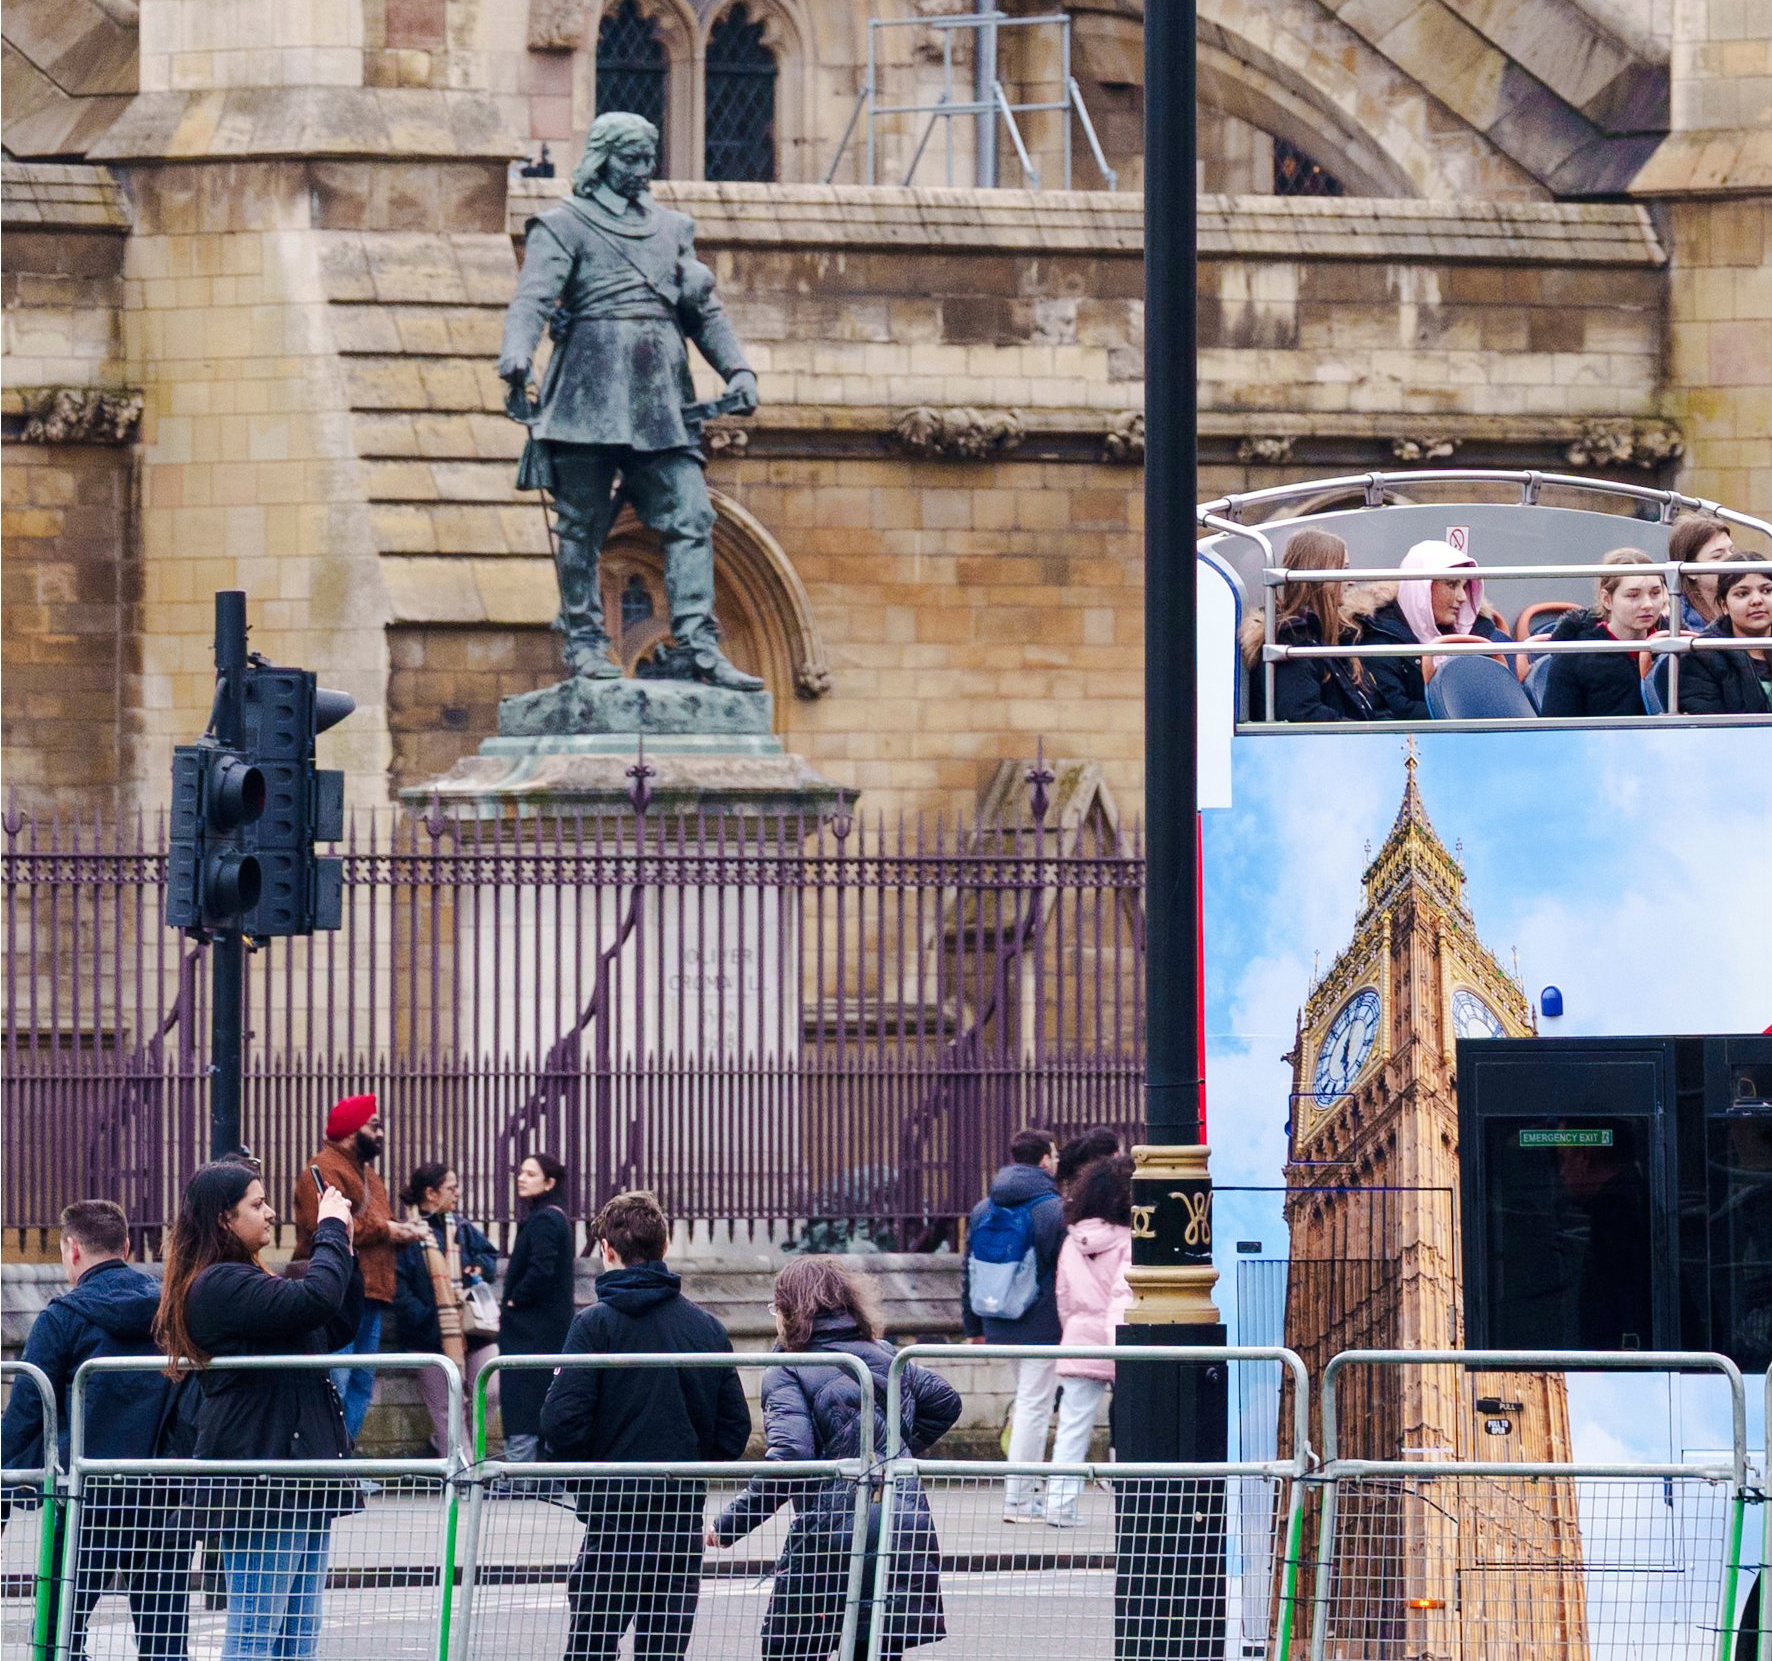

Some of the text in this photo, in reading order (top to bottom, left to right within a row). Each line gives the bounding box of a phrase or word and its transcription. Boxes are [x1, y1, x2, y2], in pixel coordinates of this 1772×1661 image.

[1523, 1132, 1598, 1143] EMERGENCY EXIT
[1499, 1402, 1516, 1411] PULL
